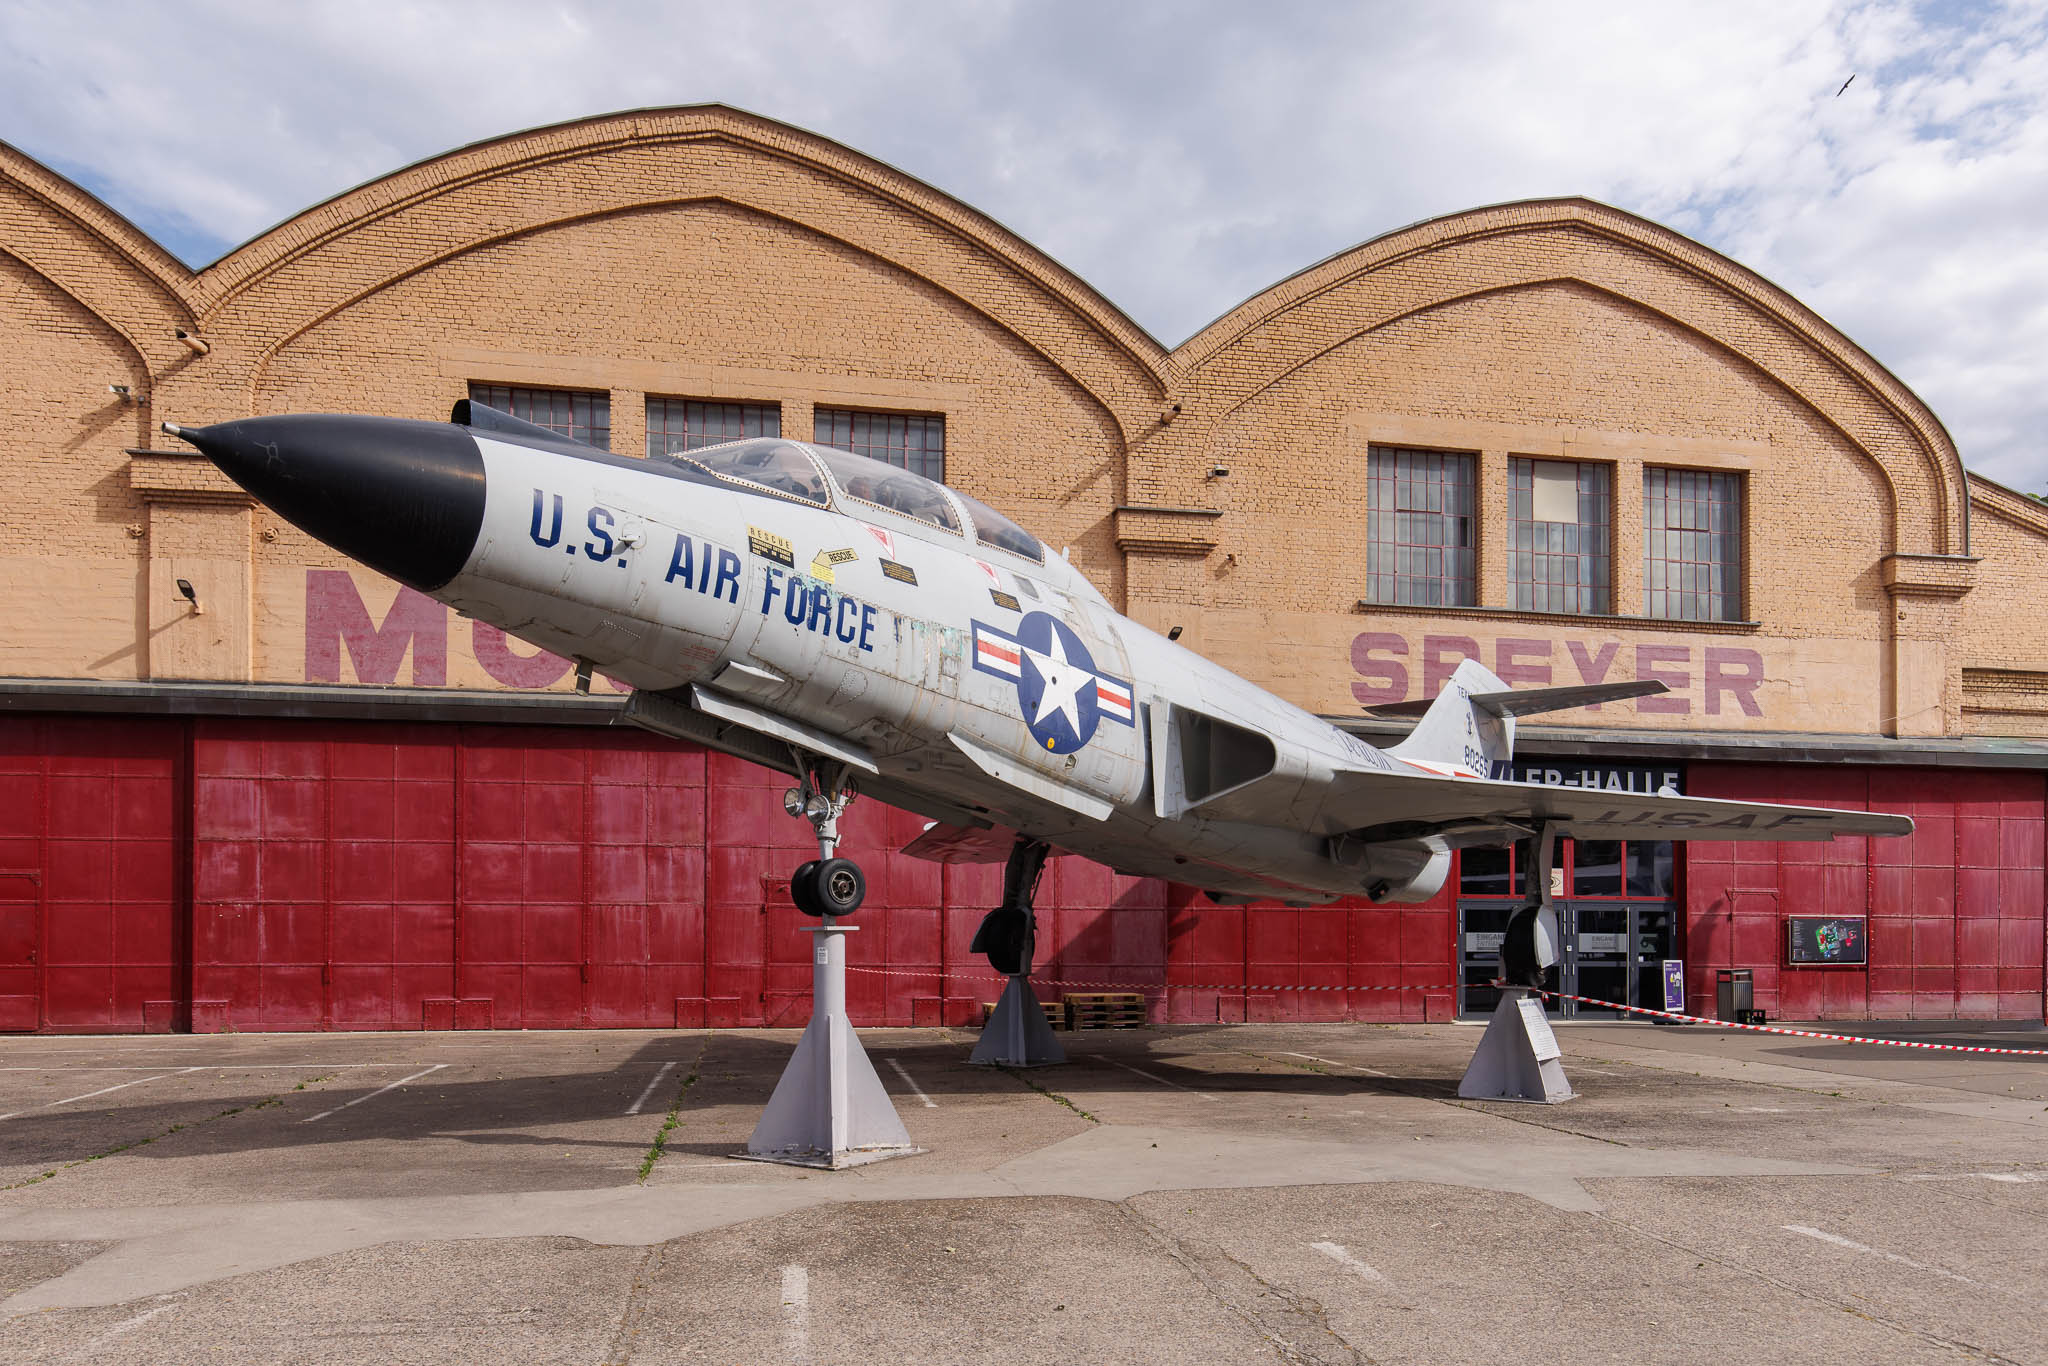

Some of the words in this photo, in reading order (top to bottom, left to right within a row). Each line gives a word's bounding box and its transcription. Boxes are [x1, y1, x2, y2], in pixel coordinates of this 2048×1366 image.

[750, 527, 790, 550] RESCUE
[530, 488, 628, 568] U.S.
[664, 533, 741, 604] AIR
[761, 565, 876, 652] FORCE
[829, 550, 854, 563] RESCUE
[1350, 631, 1765, 718] SPEYER
[1464, 745, 1489, 778] 80265
[1591, 810, 1834, 829] USAF
